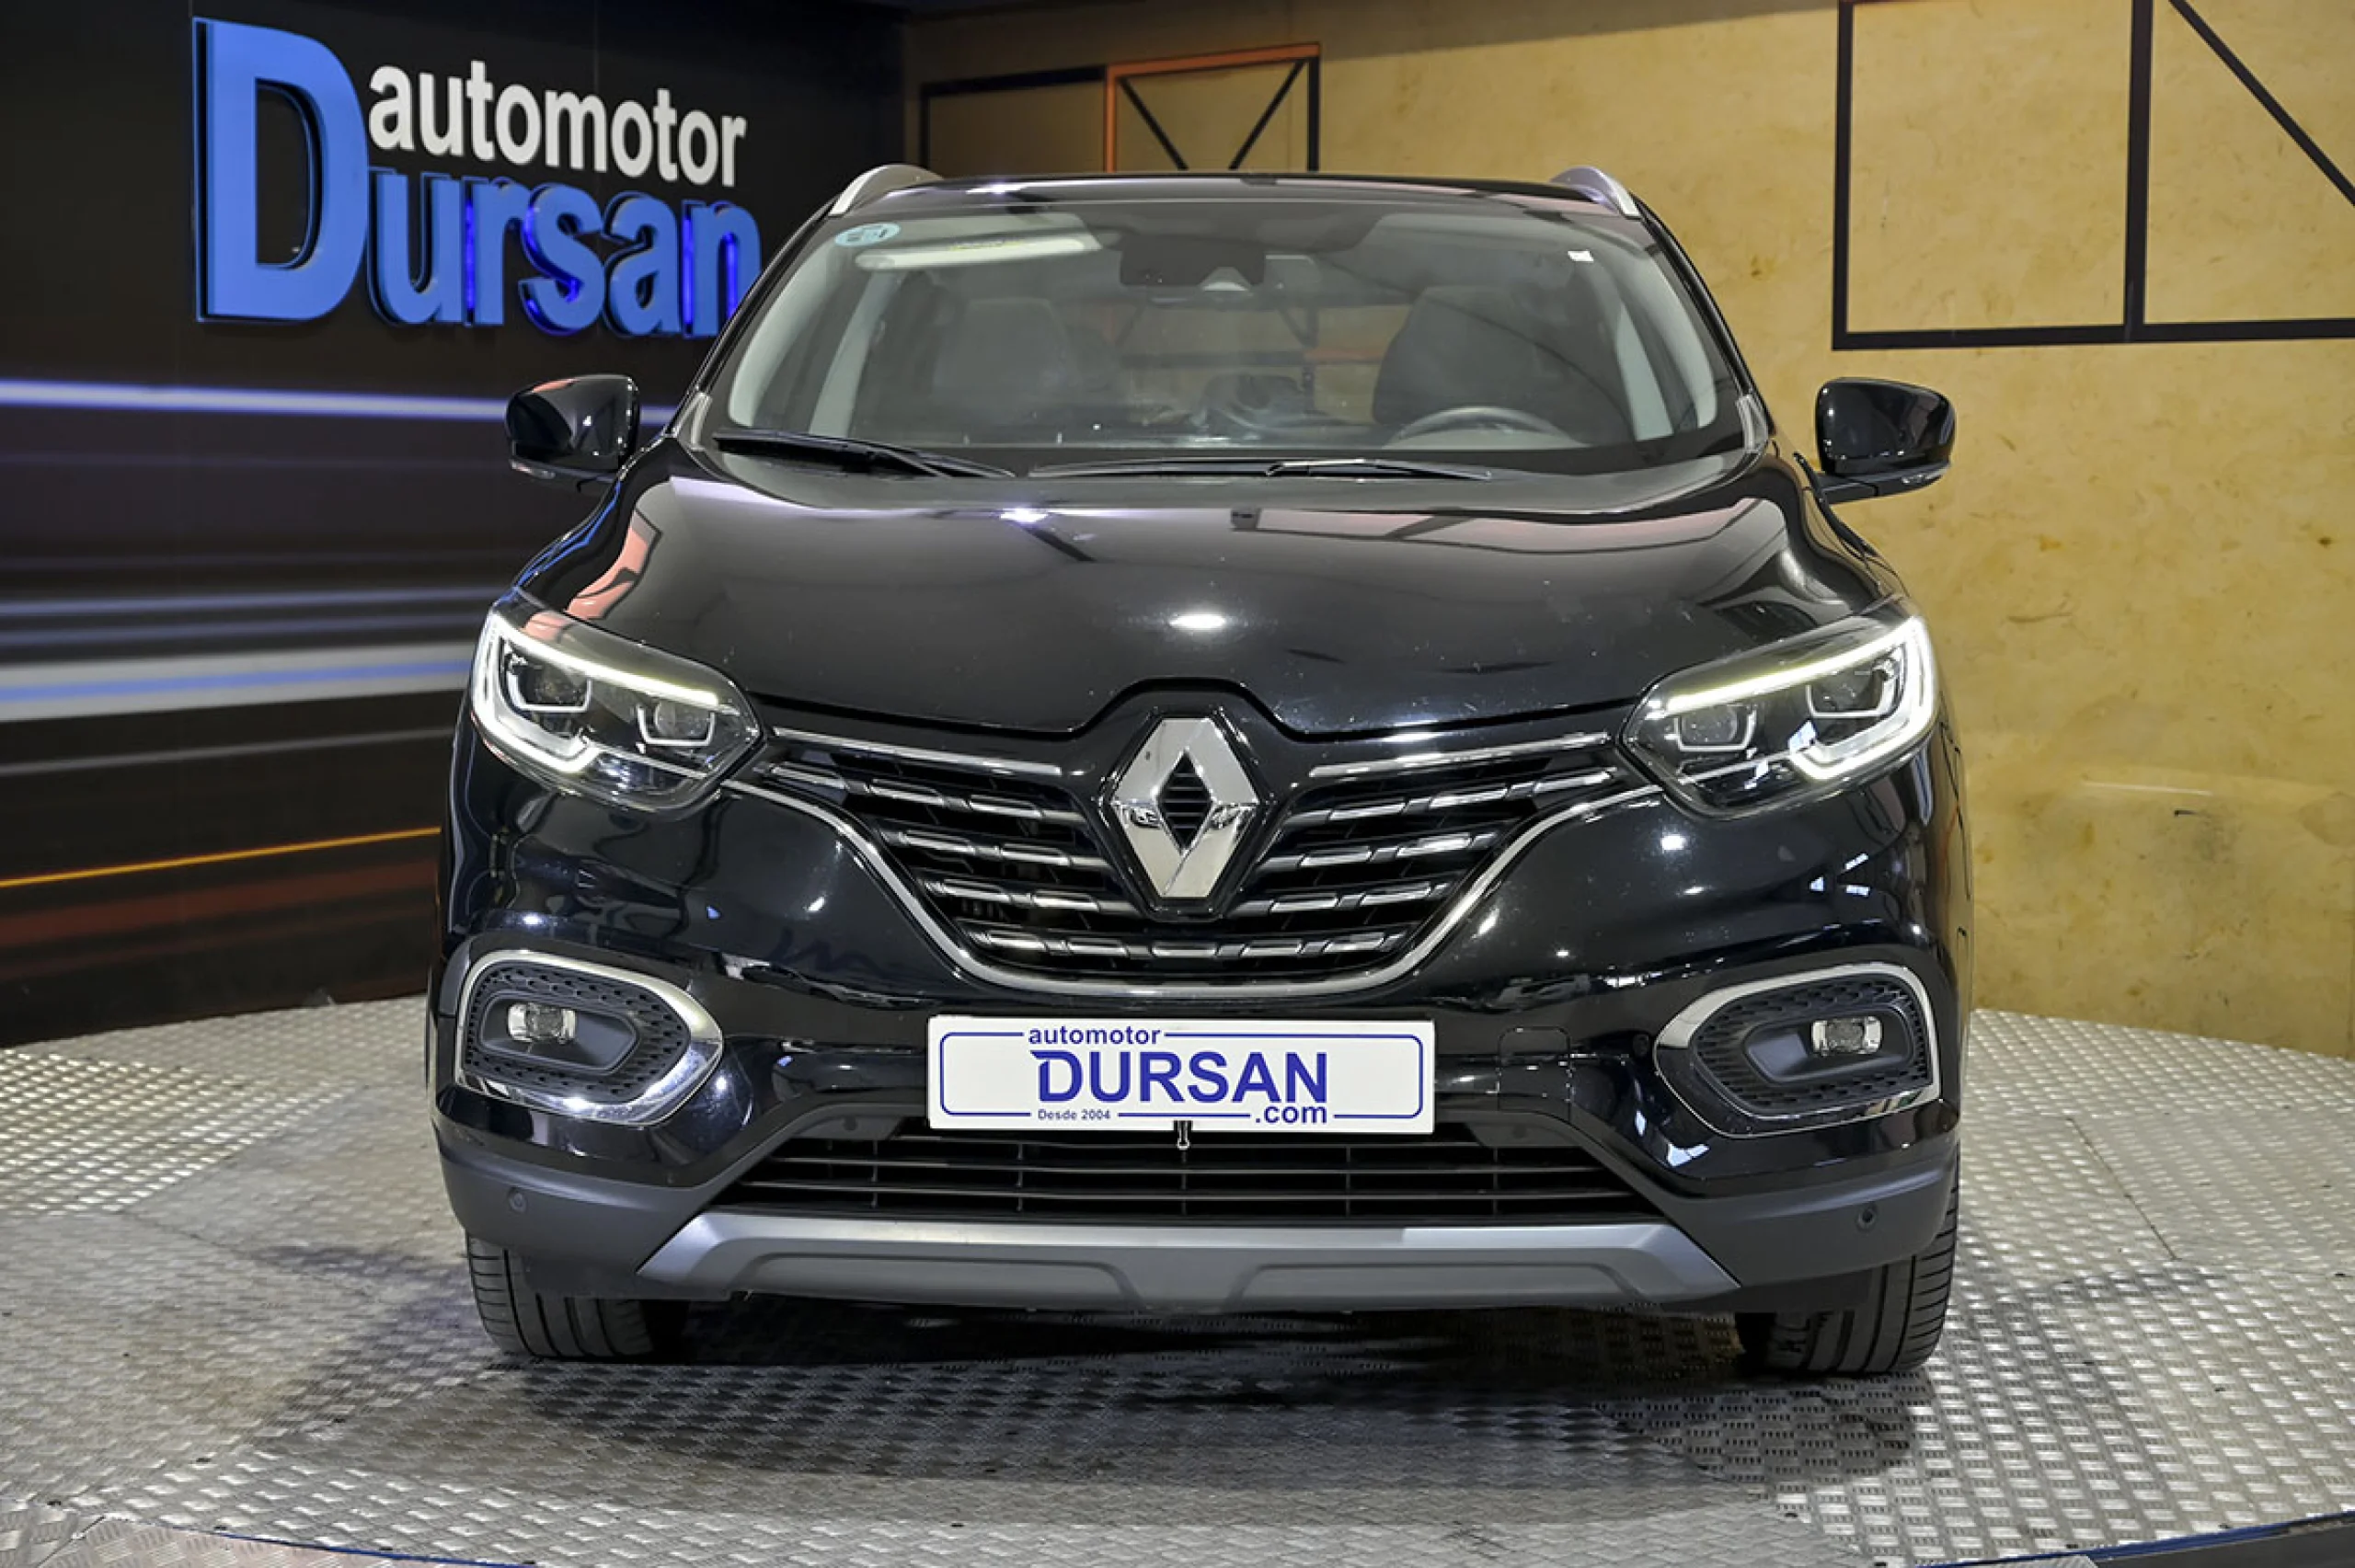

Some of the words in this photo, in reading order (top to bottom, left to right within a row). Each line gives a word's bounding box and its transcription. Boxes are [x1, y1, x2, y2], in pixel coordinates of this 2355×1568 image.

[369, 60, 747, 188] automotor
[192, 17, 763, 338] Dursan
[1028, 1025, 1161, 1045] automotor
[1029, 1049, 1327, 1103] DURSAN
[1037, 1108, 1078, 1121] Desde
[1081, 1108, 1111, 1121] 2004
[1255, 1105, 1327, 1125] .com
